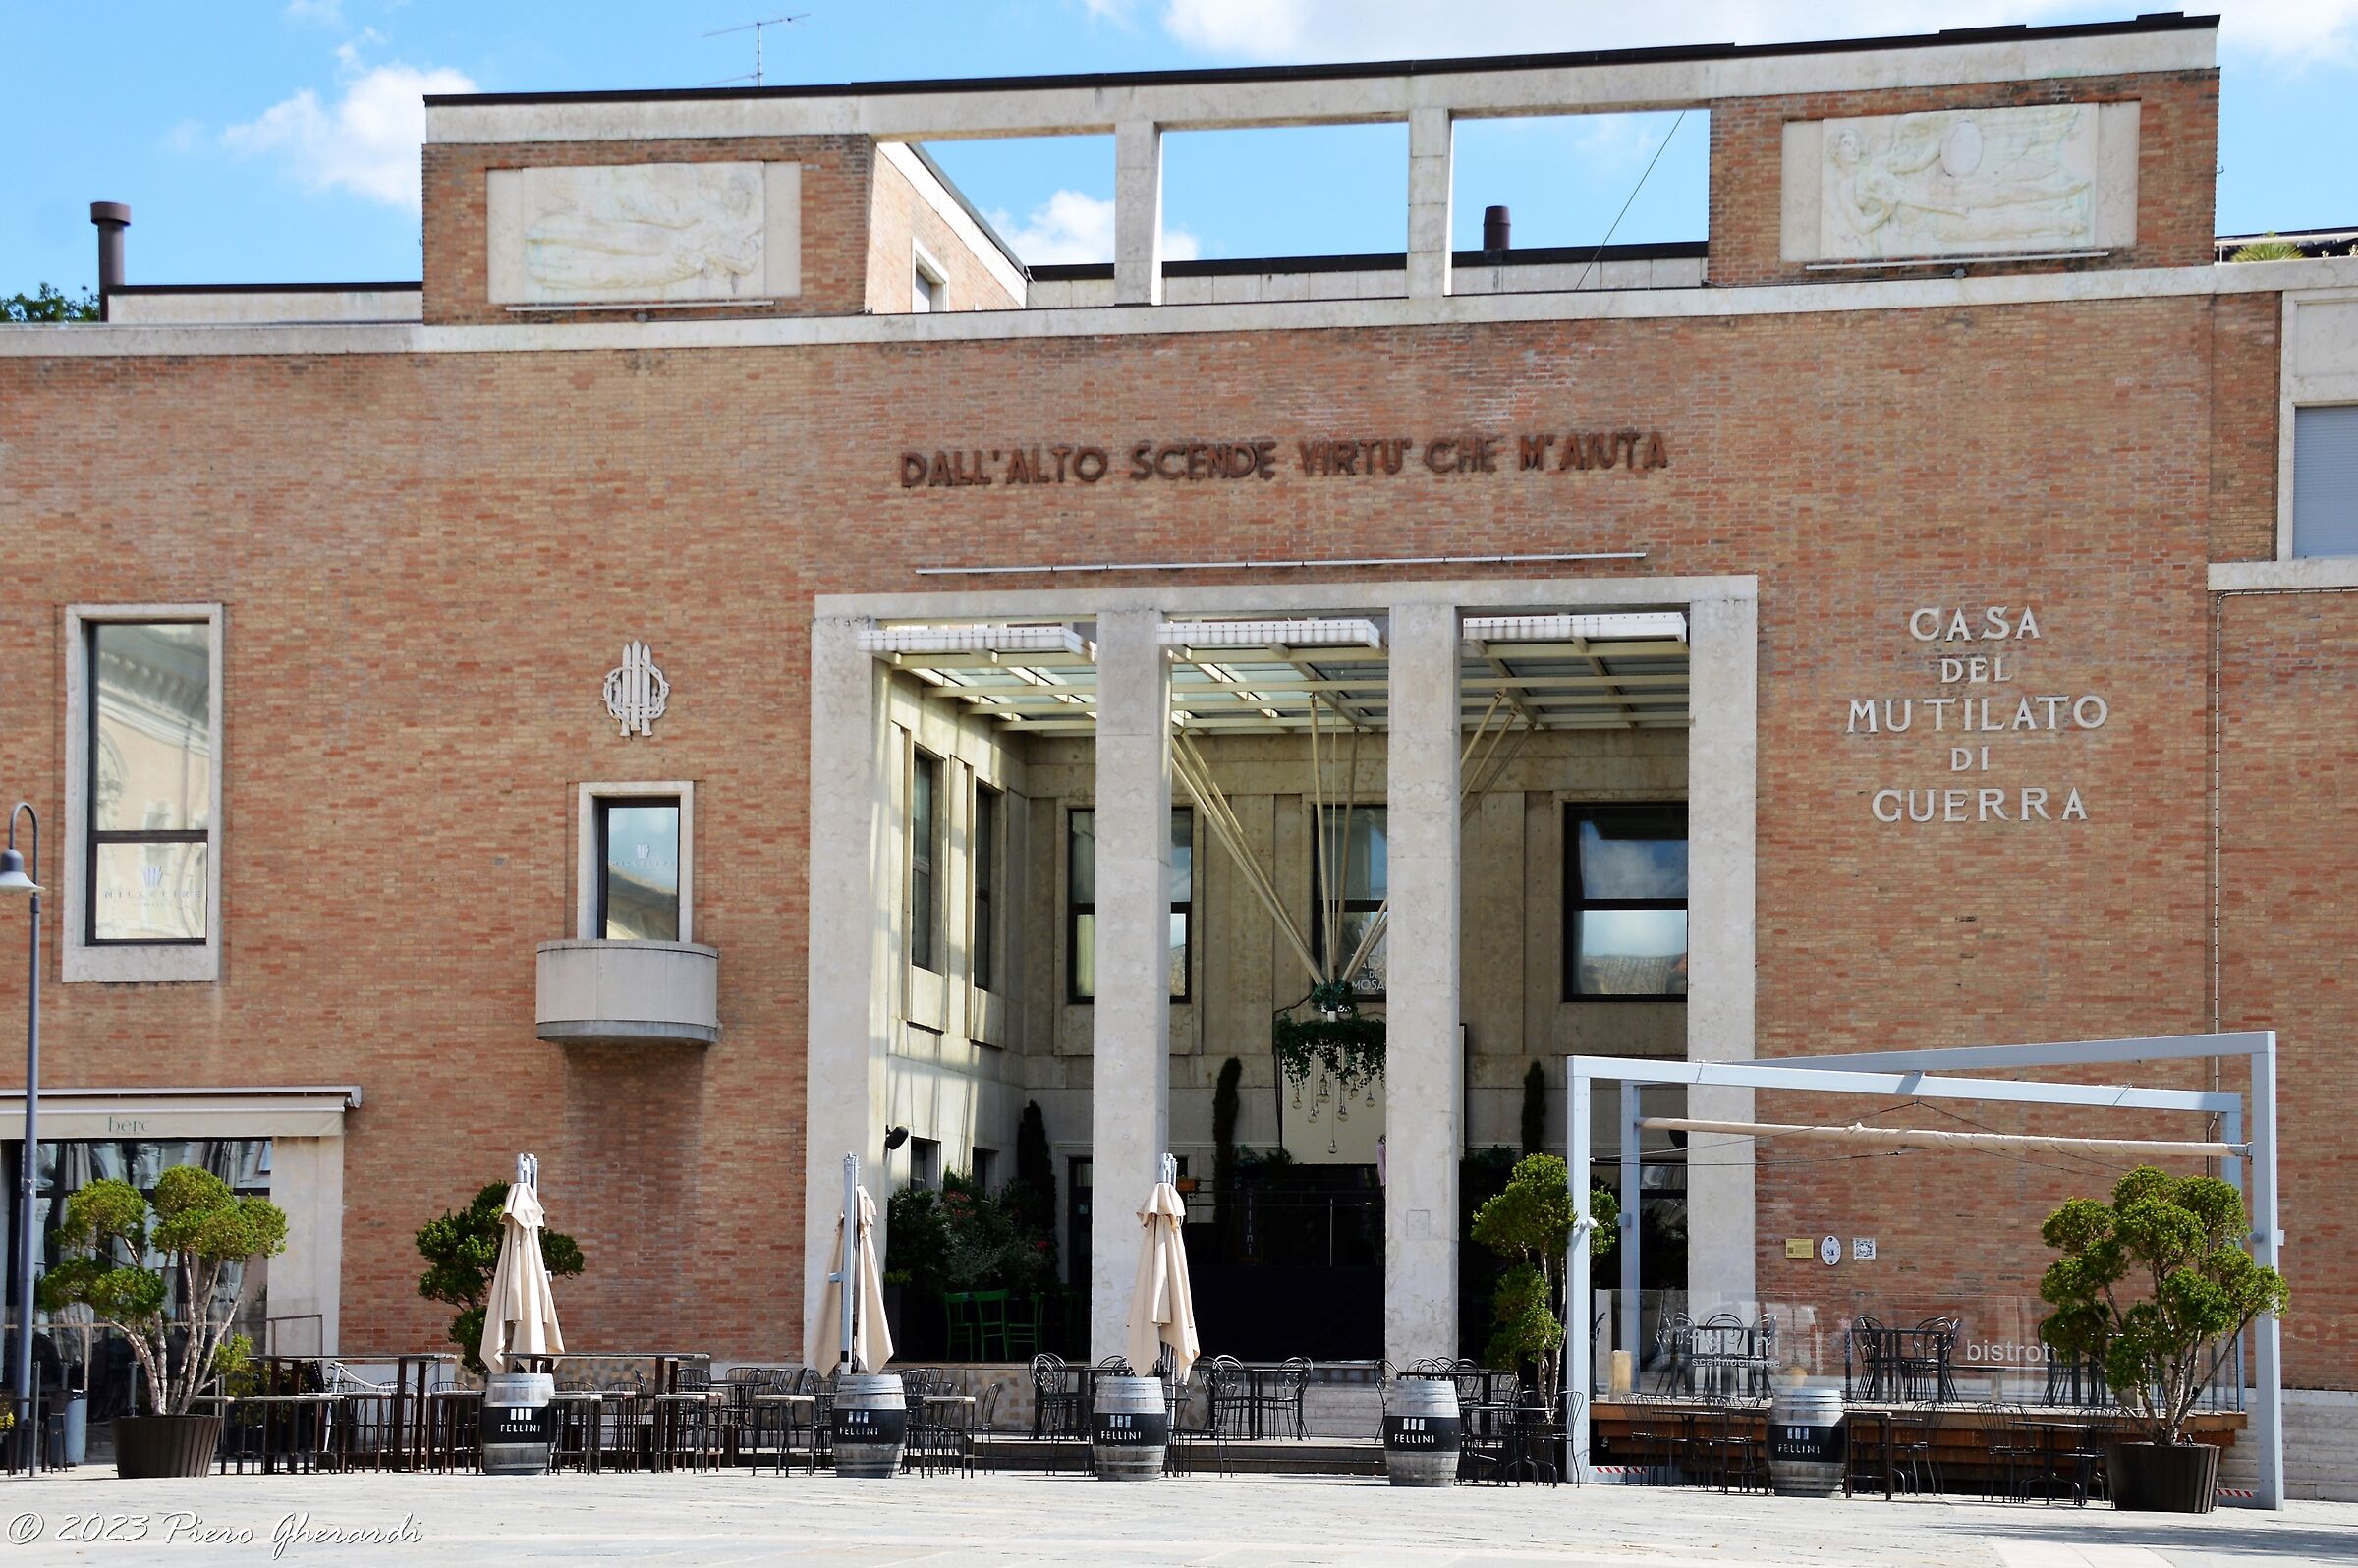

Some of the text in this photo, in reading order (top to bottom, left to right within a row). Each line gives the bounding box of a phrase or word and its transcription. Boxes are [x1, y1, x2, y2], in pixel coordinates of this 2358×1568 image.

[900, 431, 1669, 489] DALL'ALTO SCENDE VIRTU' CHE M'AIUTA
[1909, 605, 2041, 642] CASA
[1940, 656, 2013, 683] DEL
[1846, 695, 2108, 733] MUTILATO
[1950, 746, 1989, 771] DI
[1872, 786, 2089, 822] GUERRA
[1351, 980, 1385, 991] MOSA
[1966, 1339, 2050, 1363] bistrot
[500, 1424, 541, 1432] FELLINI
[839, 1427, 878, 1435] FELLINI
[1100, 1430, 1142, 1440] FELLINI
[1394, 1433, 1435, 1444] FELLINI
[1777, 1443, 1821, 1454] FELLINI
